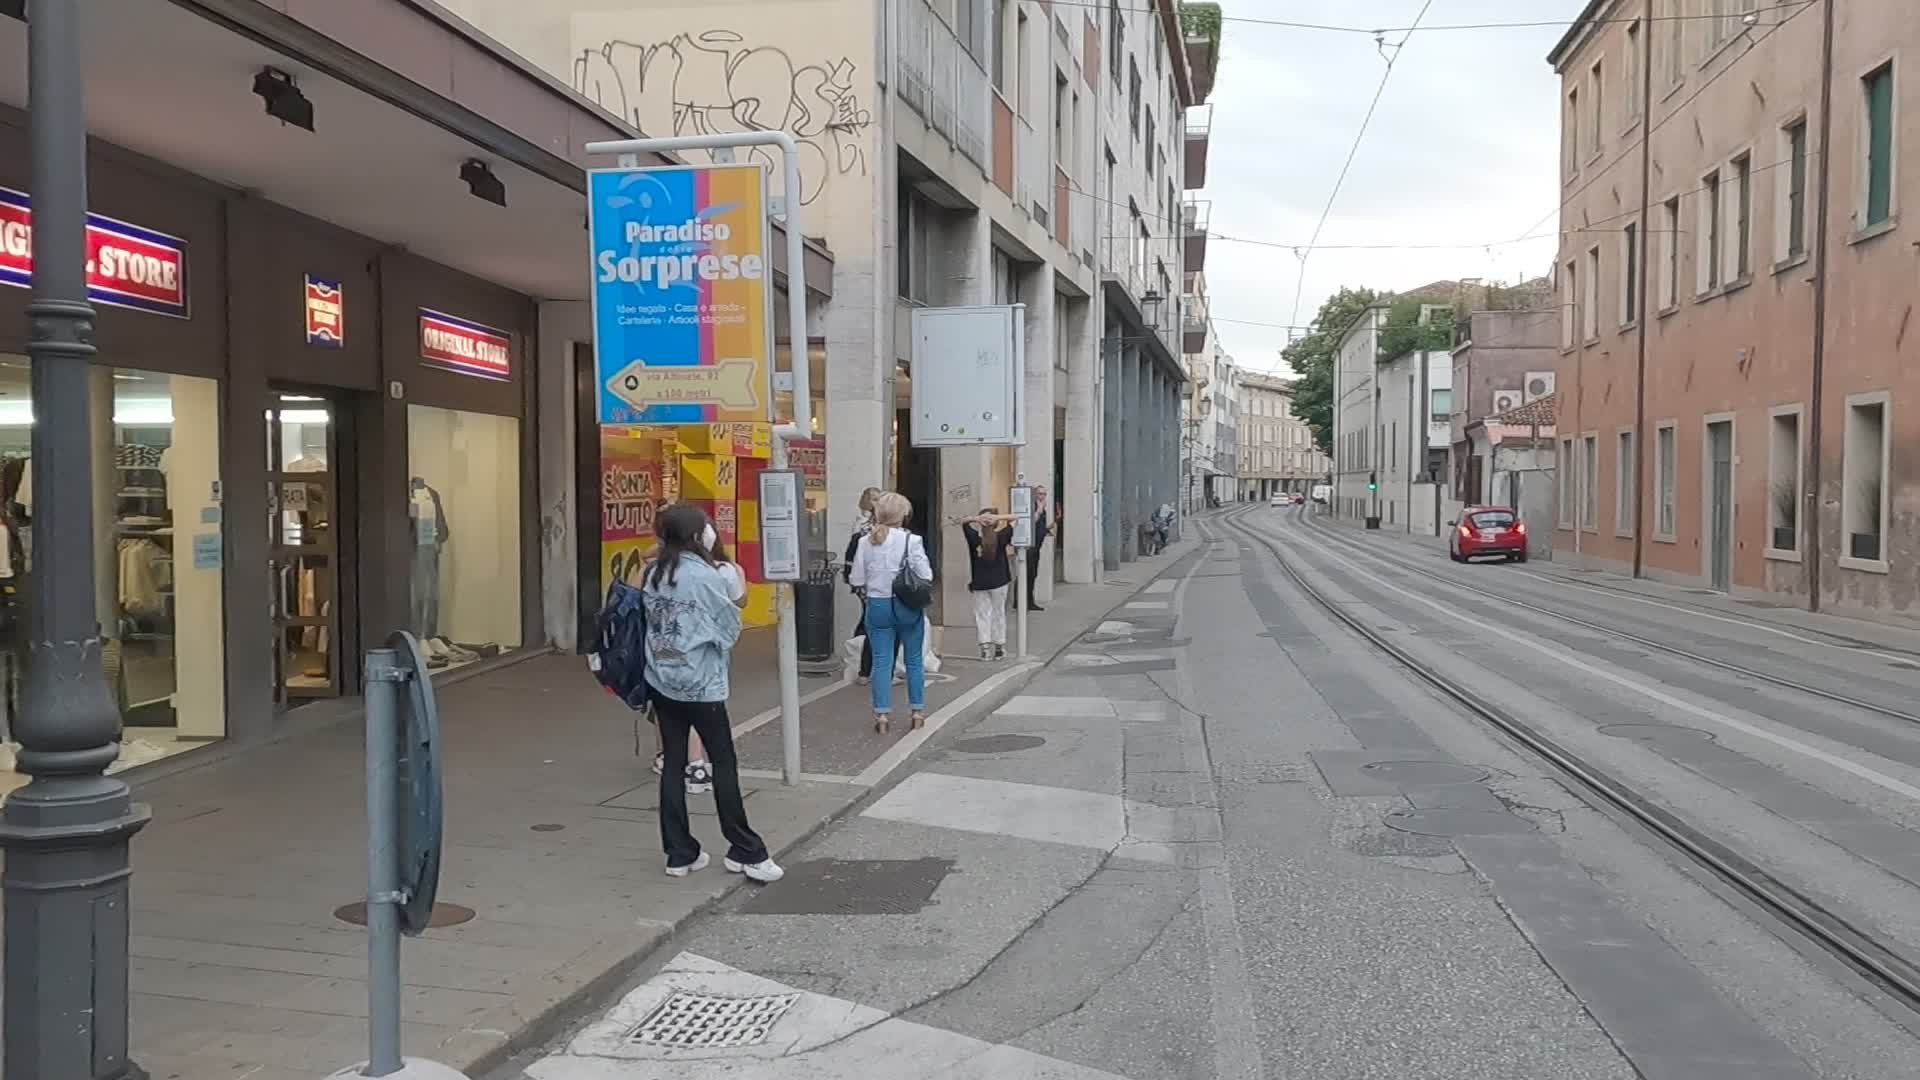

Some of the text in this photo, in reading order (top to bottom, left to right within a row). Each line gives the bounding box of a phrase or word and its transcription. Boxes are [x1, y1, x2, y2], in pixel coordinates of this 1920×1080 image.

[625, 216, 731, 243] Paradiso
[99, 245, 177, 291] STORE
[598, 250, 762, 290] Sorprese
[674, 303, 698, 312] Casa
[423, 327, 508, 366] ORIGINAL STORE
[605, 500, 655, 529] TUTTO
